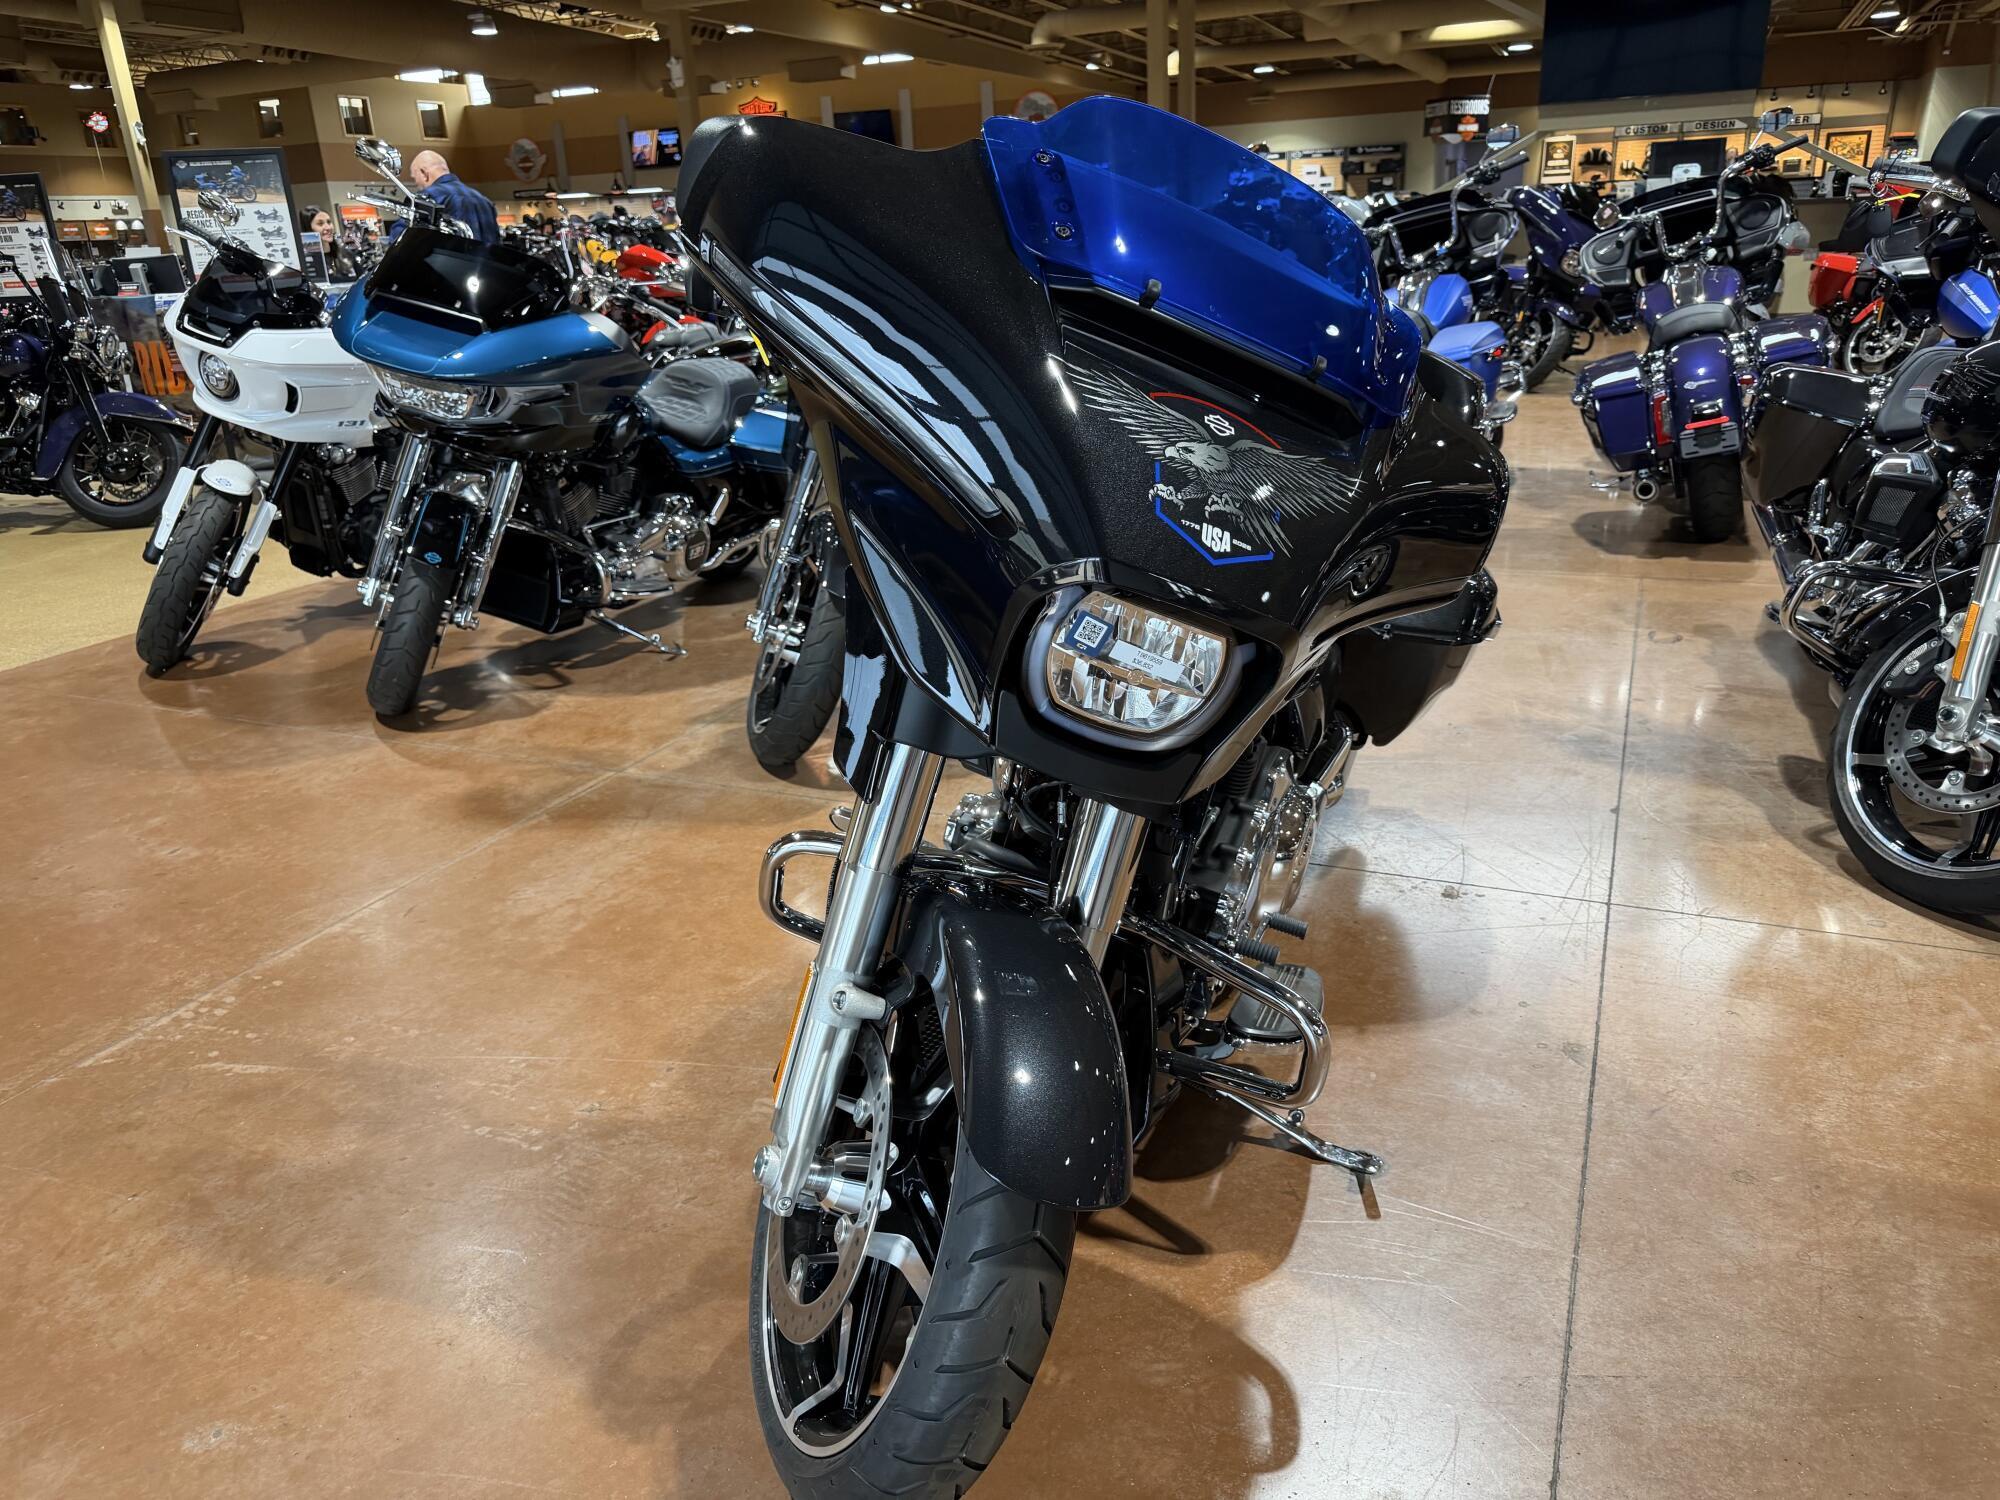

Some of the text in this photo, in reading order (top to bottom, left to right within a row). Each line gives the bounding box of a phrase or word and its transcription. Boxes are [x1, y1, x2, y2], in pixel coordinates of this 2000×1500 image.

[1450, 99, 1490, 115] RESTROOMS
[1625, 120, 1736, 135] CUSTOM DESIGN
[1181, 519, 1200, 530] 1776
[1201, 522, 1231, 553] USA
